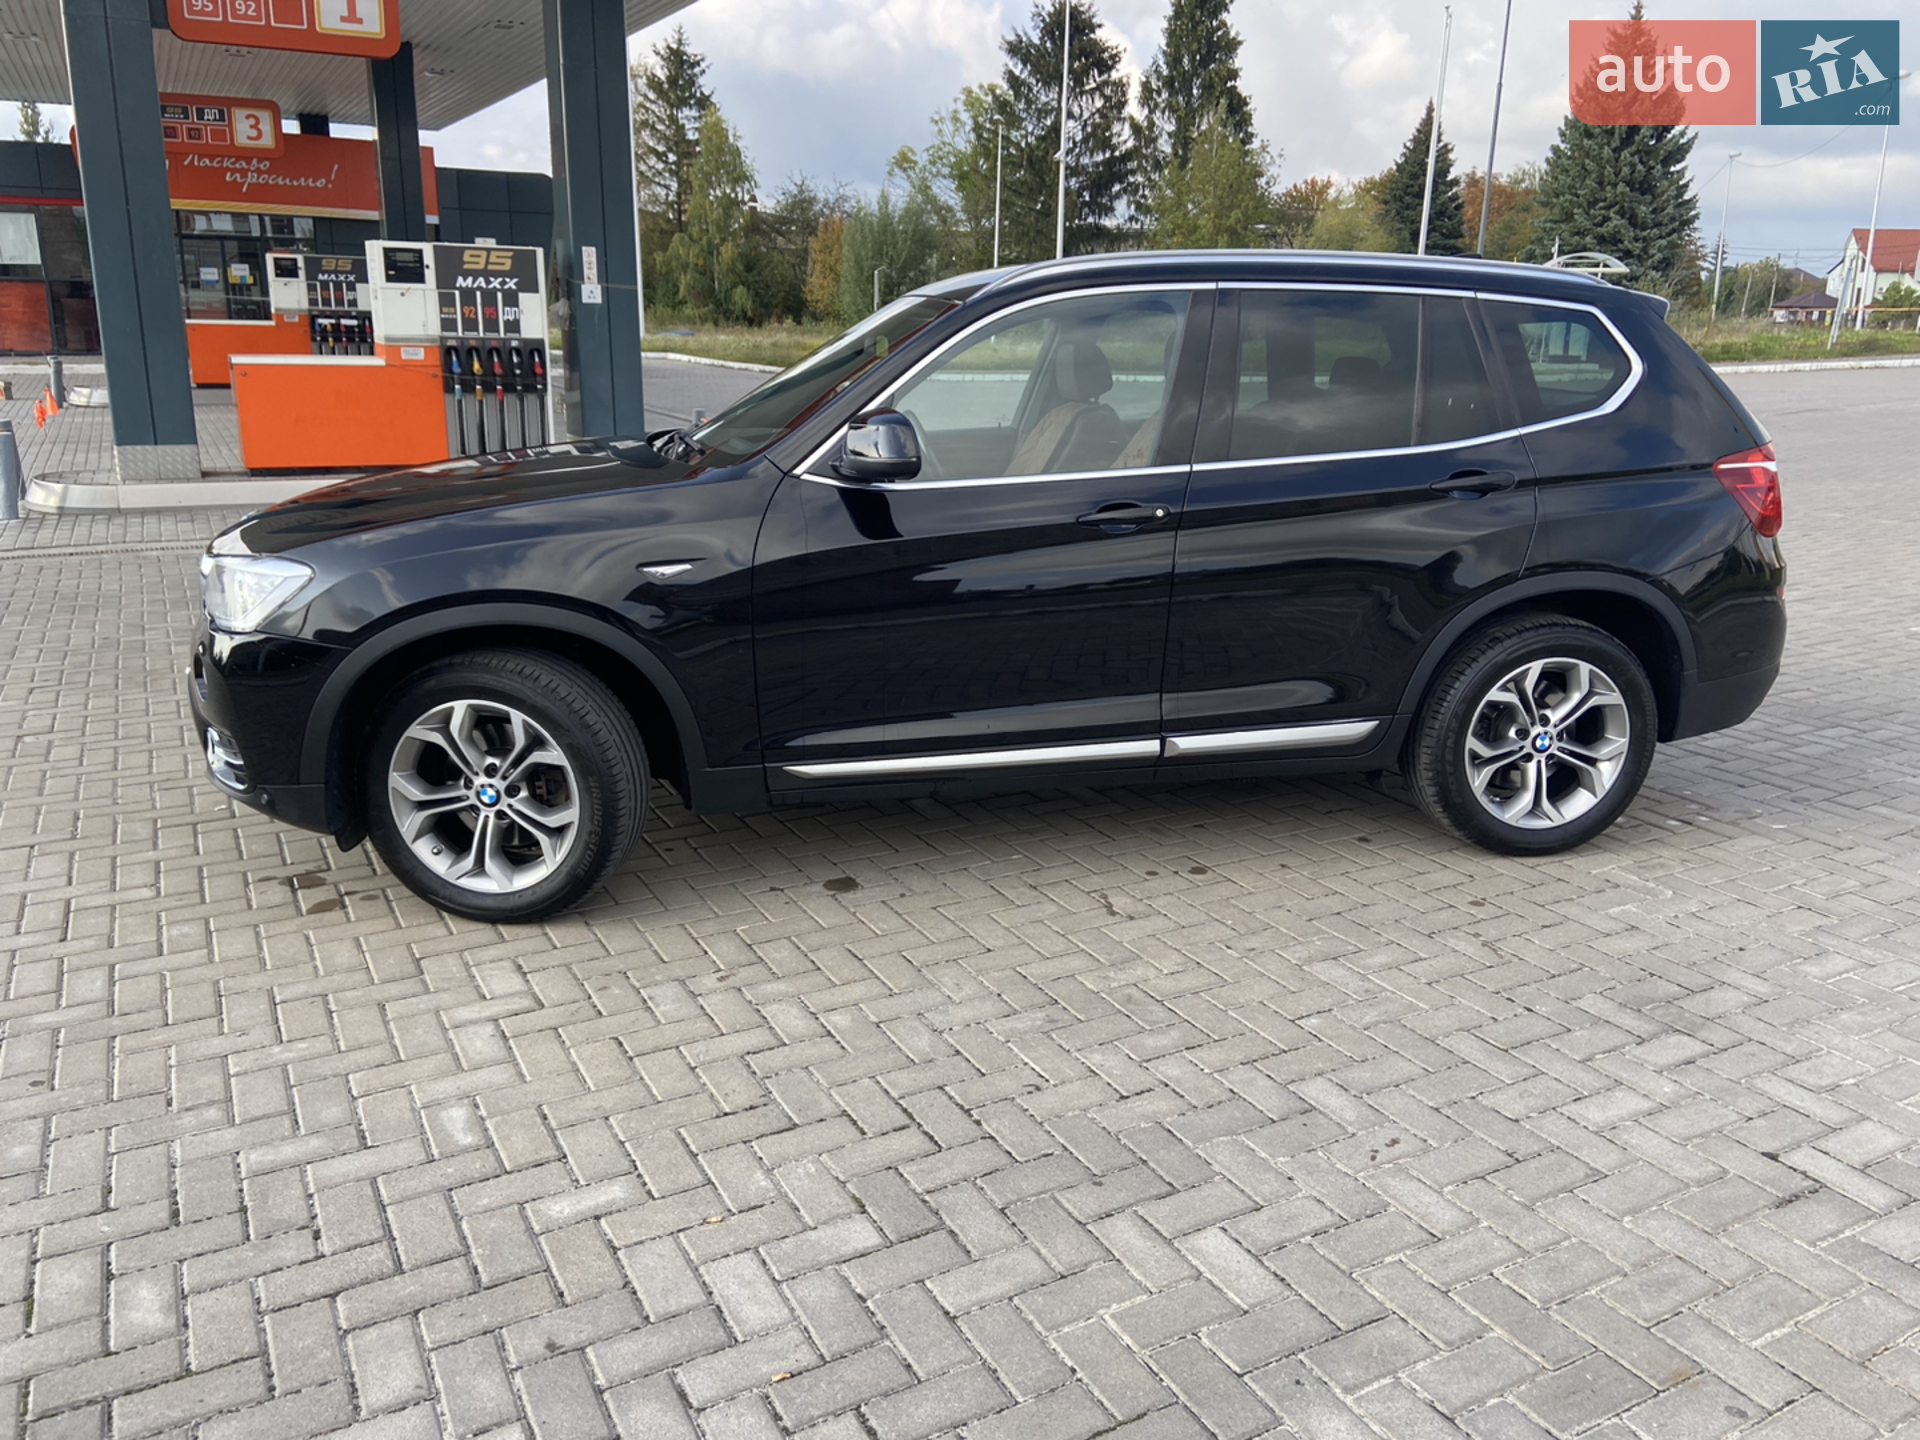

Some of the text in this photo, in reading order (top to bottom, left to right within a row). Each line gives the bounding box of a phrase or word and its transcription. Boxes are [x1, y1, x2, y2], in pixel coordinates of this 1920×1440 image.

[191, 0, 214, 12] 95
[235, 0, 257, 16] 92
[204, 108, 220, 121] ДП
[244, 113, 263, 142] 3
[225, 164, 339, 193] просимо!
[321, 258, 353, 271] 95
[463, 249, 514, 271] 95
[317, 273, 356, 282] MAXX
[456, 275, 519, 290] MAXX
[463, 306, 476, 319] 92
[484, 306, 497, 319] 95
[503, 306, 519, 322] ДП
